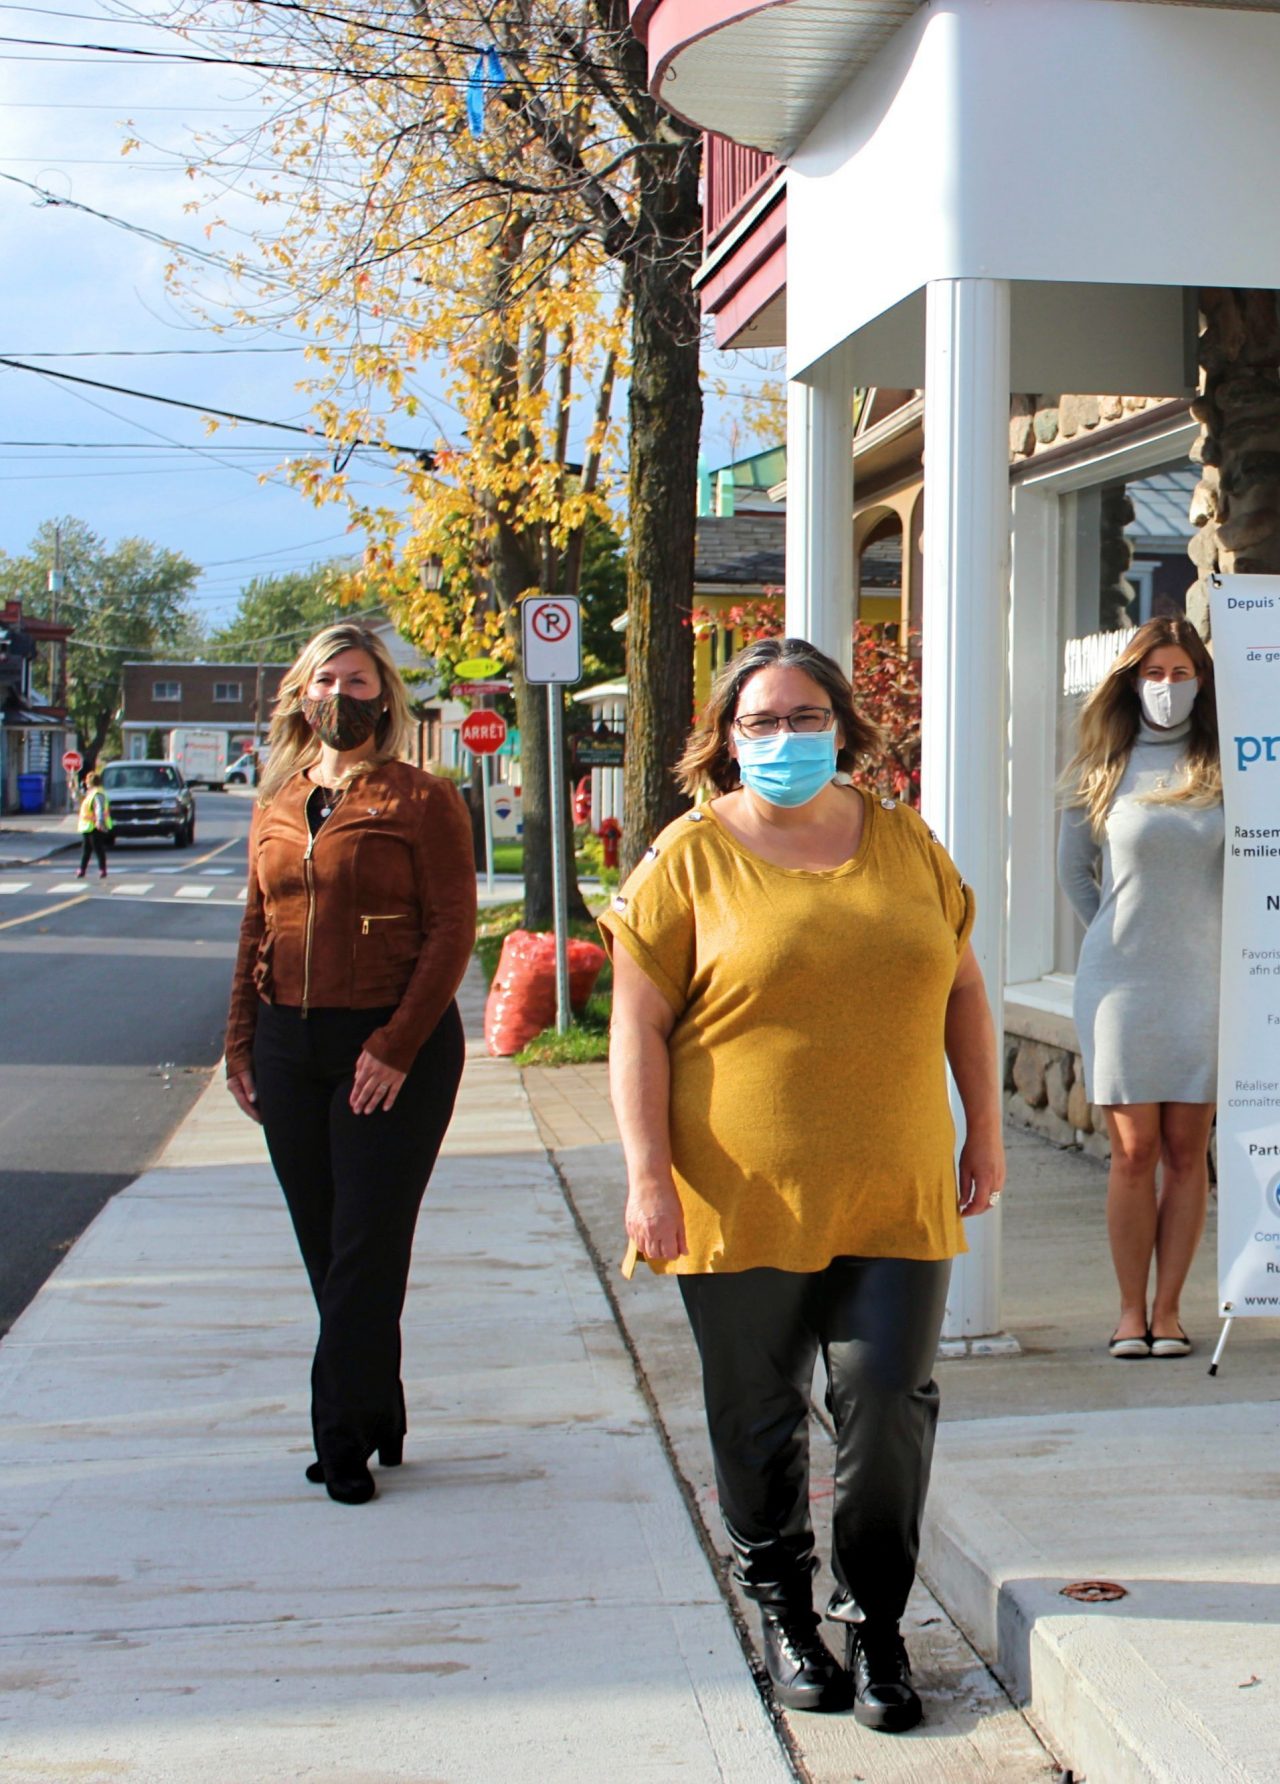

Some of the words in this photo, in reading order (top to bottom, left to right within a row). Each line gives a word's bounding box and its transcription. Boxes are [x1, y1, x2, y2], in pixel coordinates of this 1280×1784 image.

[1227, 596, 1274, 611] Depuis
[1246, 651, 1262, 661] de
[464, 723, 503, 740] ARRÊT
[1231, 844, 1241, 857] le
[1249, 964, 1271, 976] afin
[1235, 1080, 1279, 1091] Réaliser
